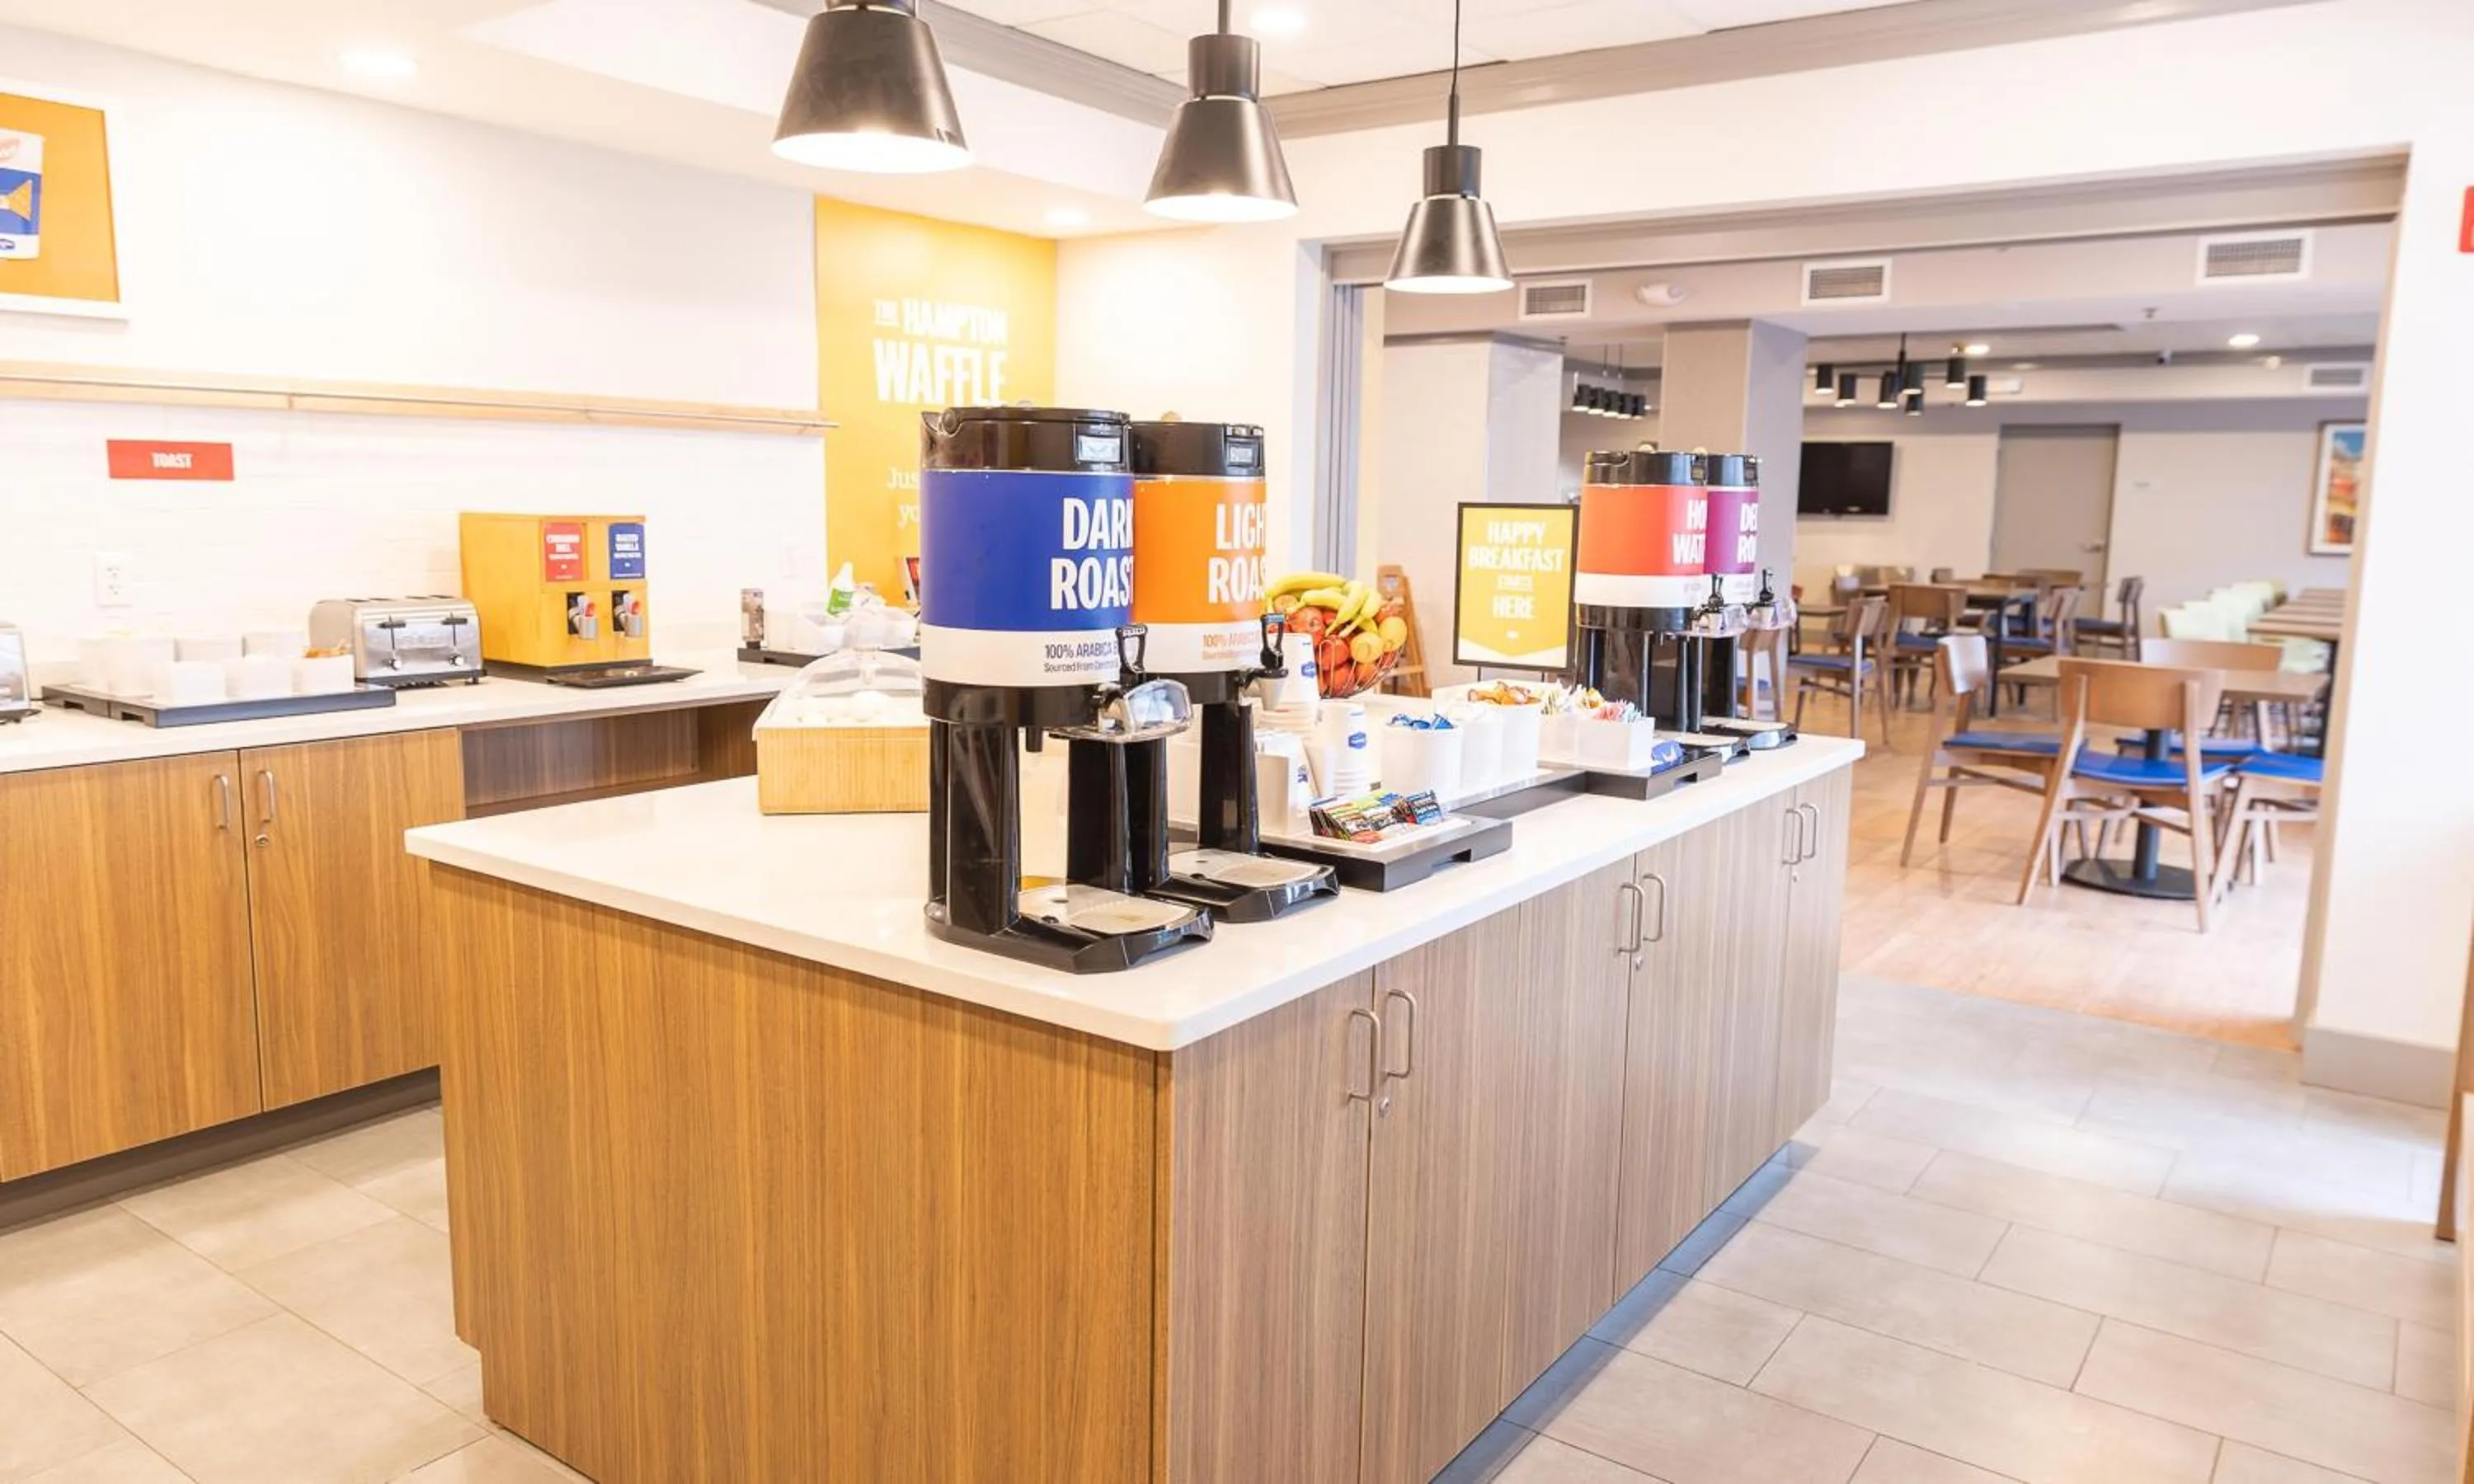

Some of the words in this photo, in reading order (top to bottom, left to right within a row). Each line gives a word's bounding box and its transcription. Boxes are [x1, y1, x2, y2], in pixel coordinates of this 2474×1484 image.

[902, 298, 1008, 346] HAMPTON
[872, 337, 1009, 408] WAFFLE
[151, 452, 193, 469] TOAST
[887, 467, 920, 489] Jus
[897, 504, 920, 530] yo
[1216, 502, 1267, 550] LIGH
[1686, 499, 1708, 530] HO
[1488, 521, 1545, 545] HAPPY
[1468, 546, 1566, 573] BREAKFAST
[1208, 554, 1267, 604] ROAS
[1493, 594, 1536, 620] HERE
[1045, 644, 1075, 659] 100%
